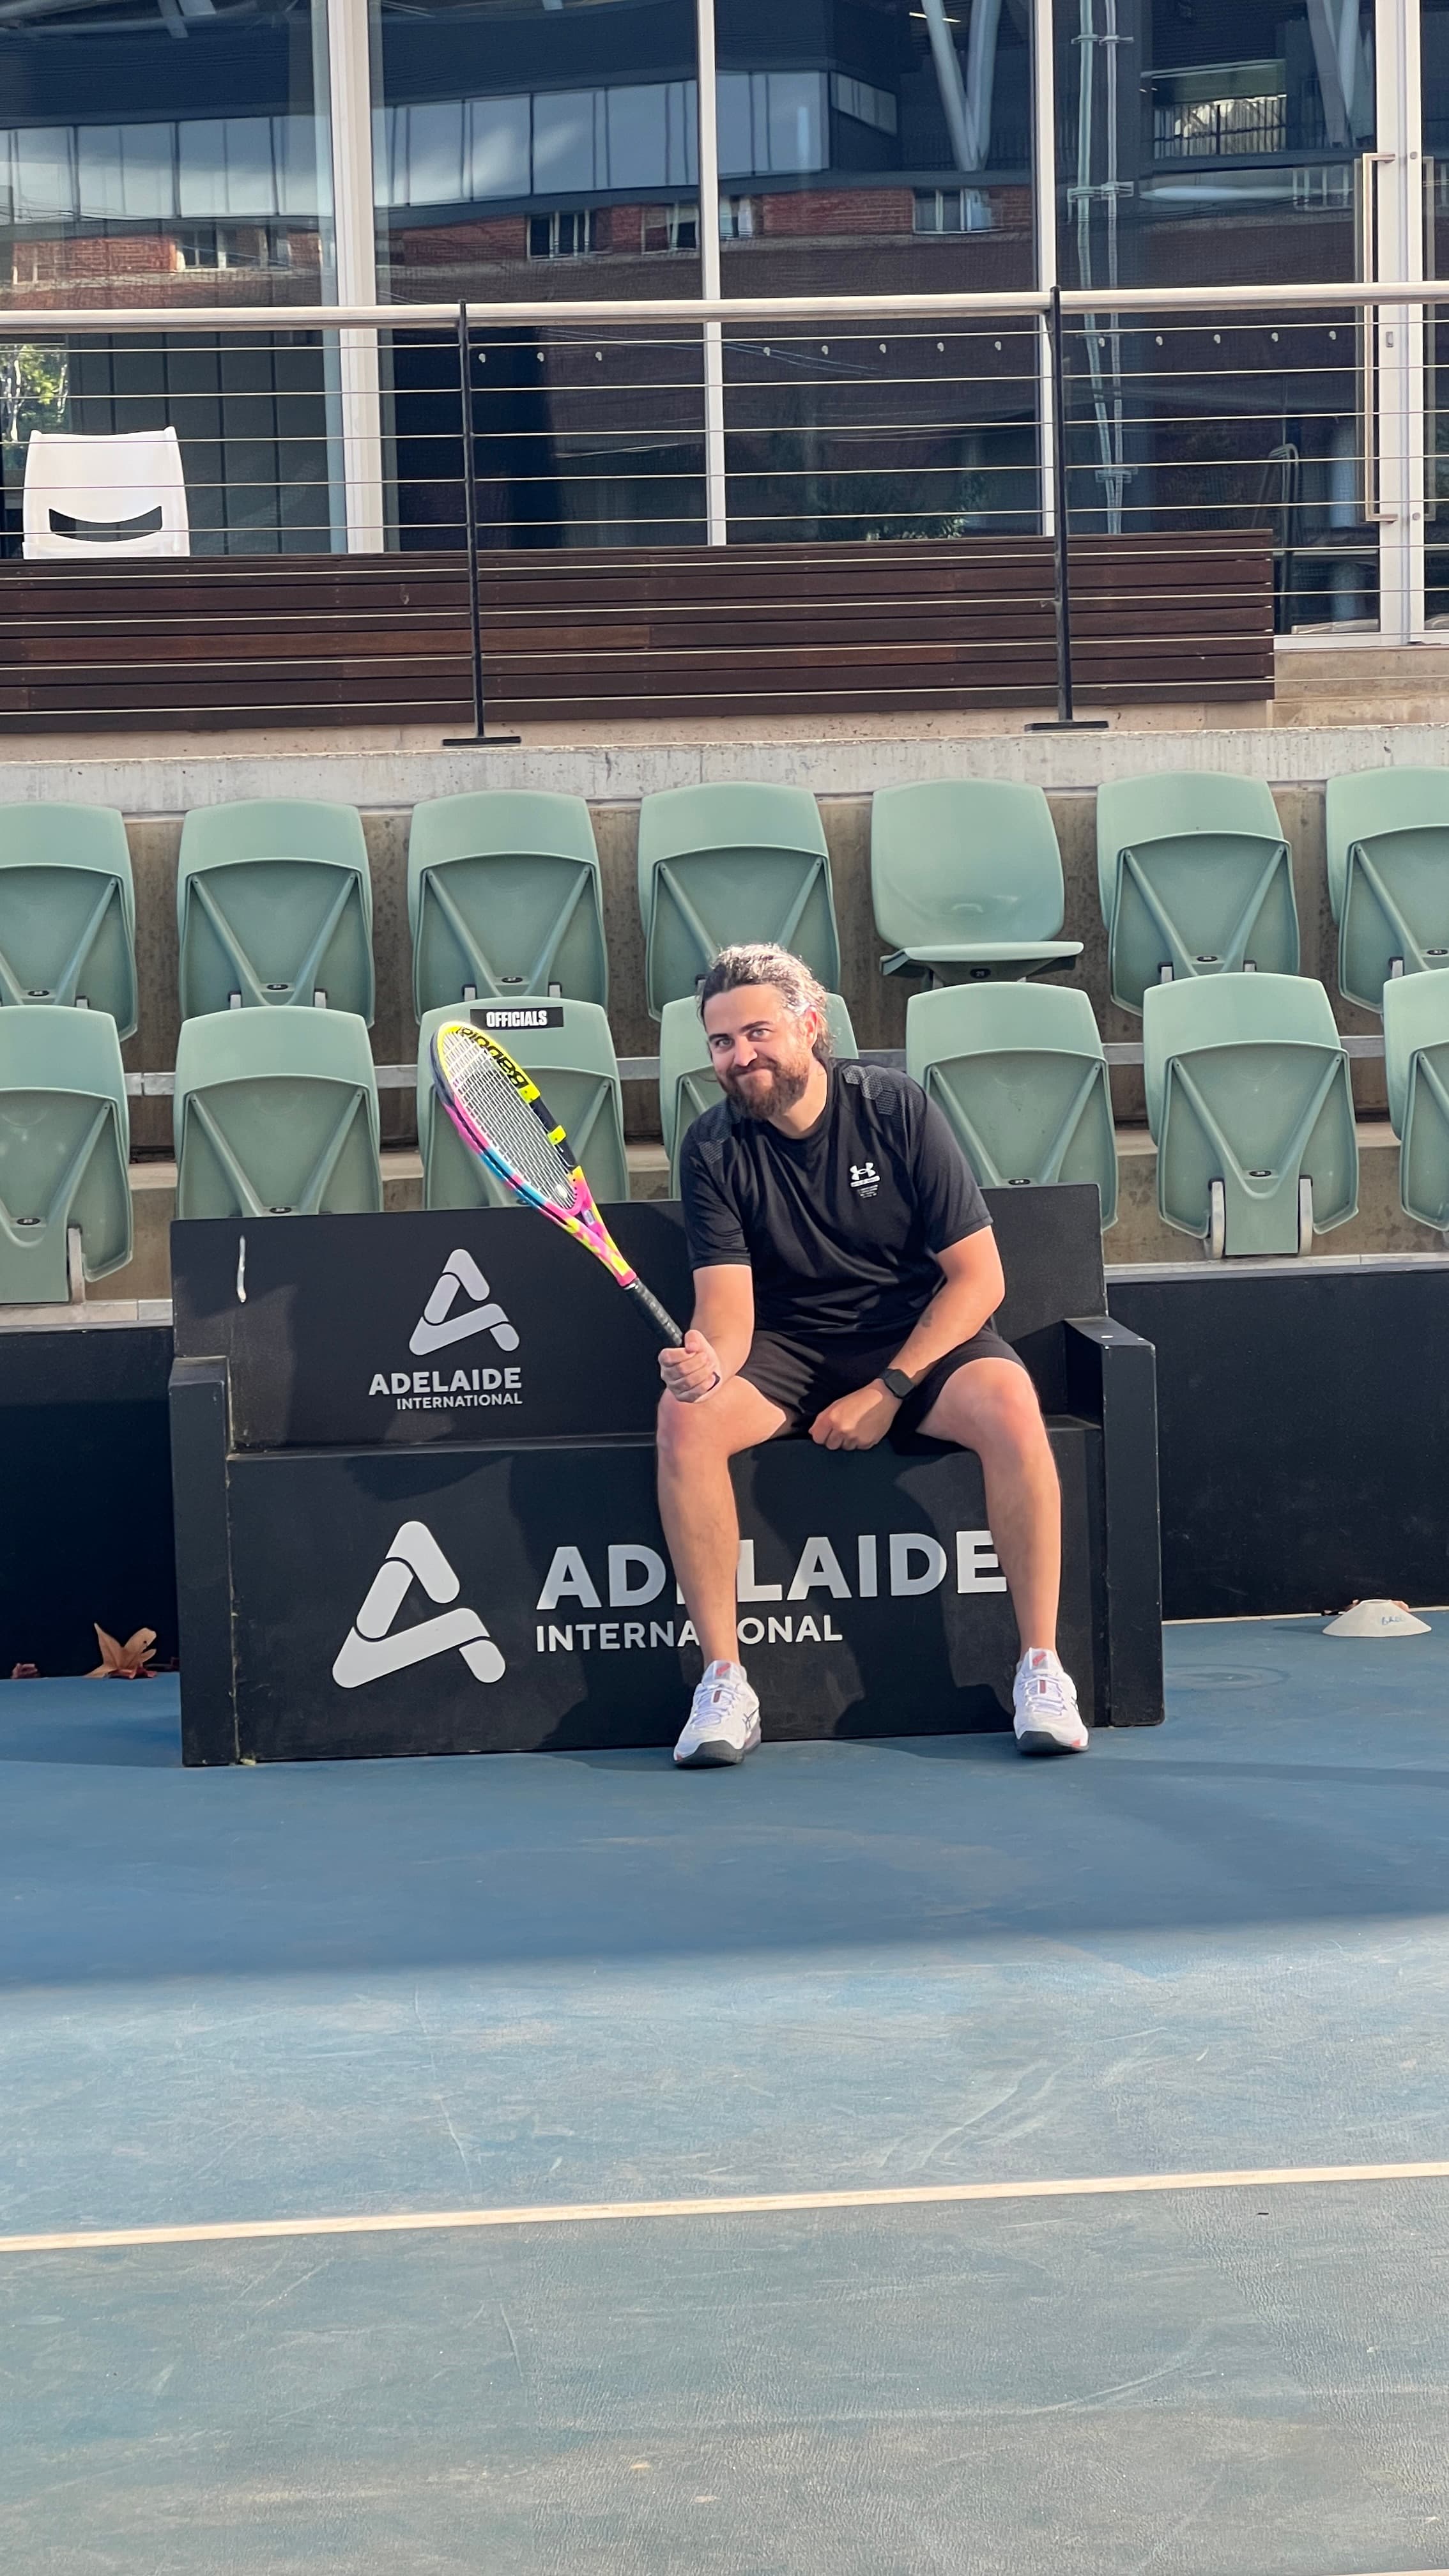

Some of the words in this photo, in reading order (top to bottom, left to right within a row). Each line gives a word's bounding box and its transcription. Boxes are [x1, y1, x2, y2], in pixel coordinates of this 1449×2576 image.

[486, 1010, 548, 1027] OFFICIALS
[369, 1367, 522, 1395] ADELAIDE
[396, 1393, 523, 1410] INTERNATIONAL
[536, 1530, 1007, 1610] ADLAIDE
[536, 1614, 843, 1652] INTERNAONAL
